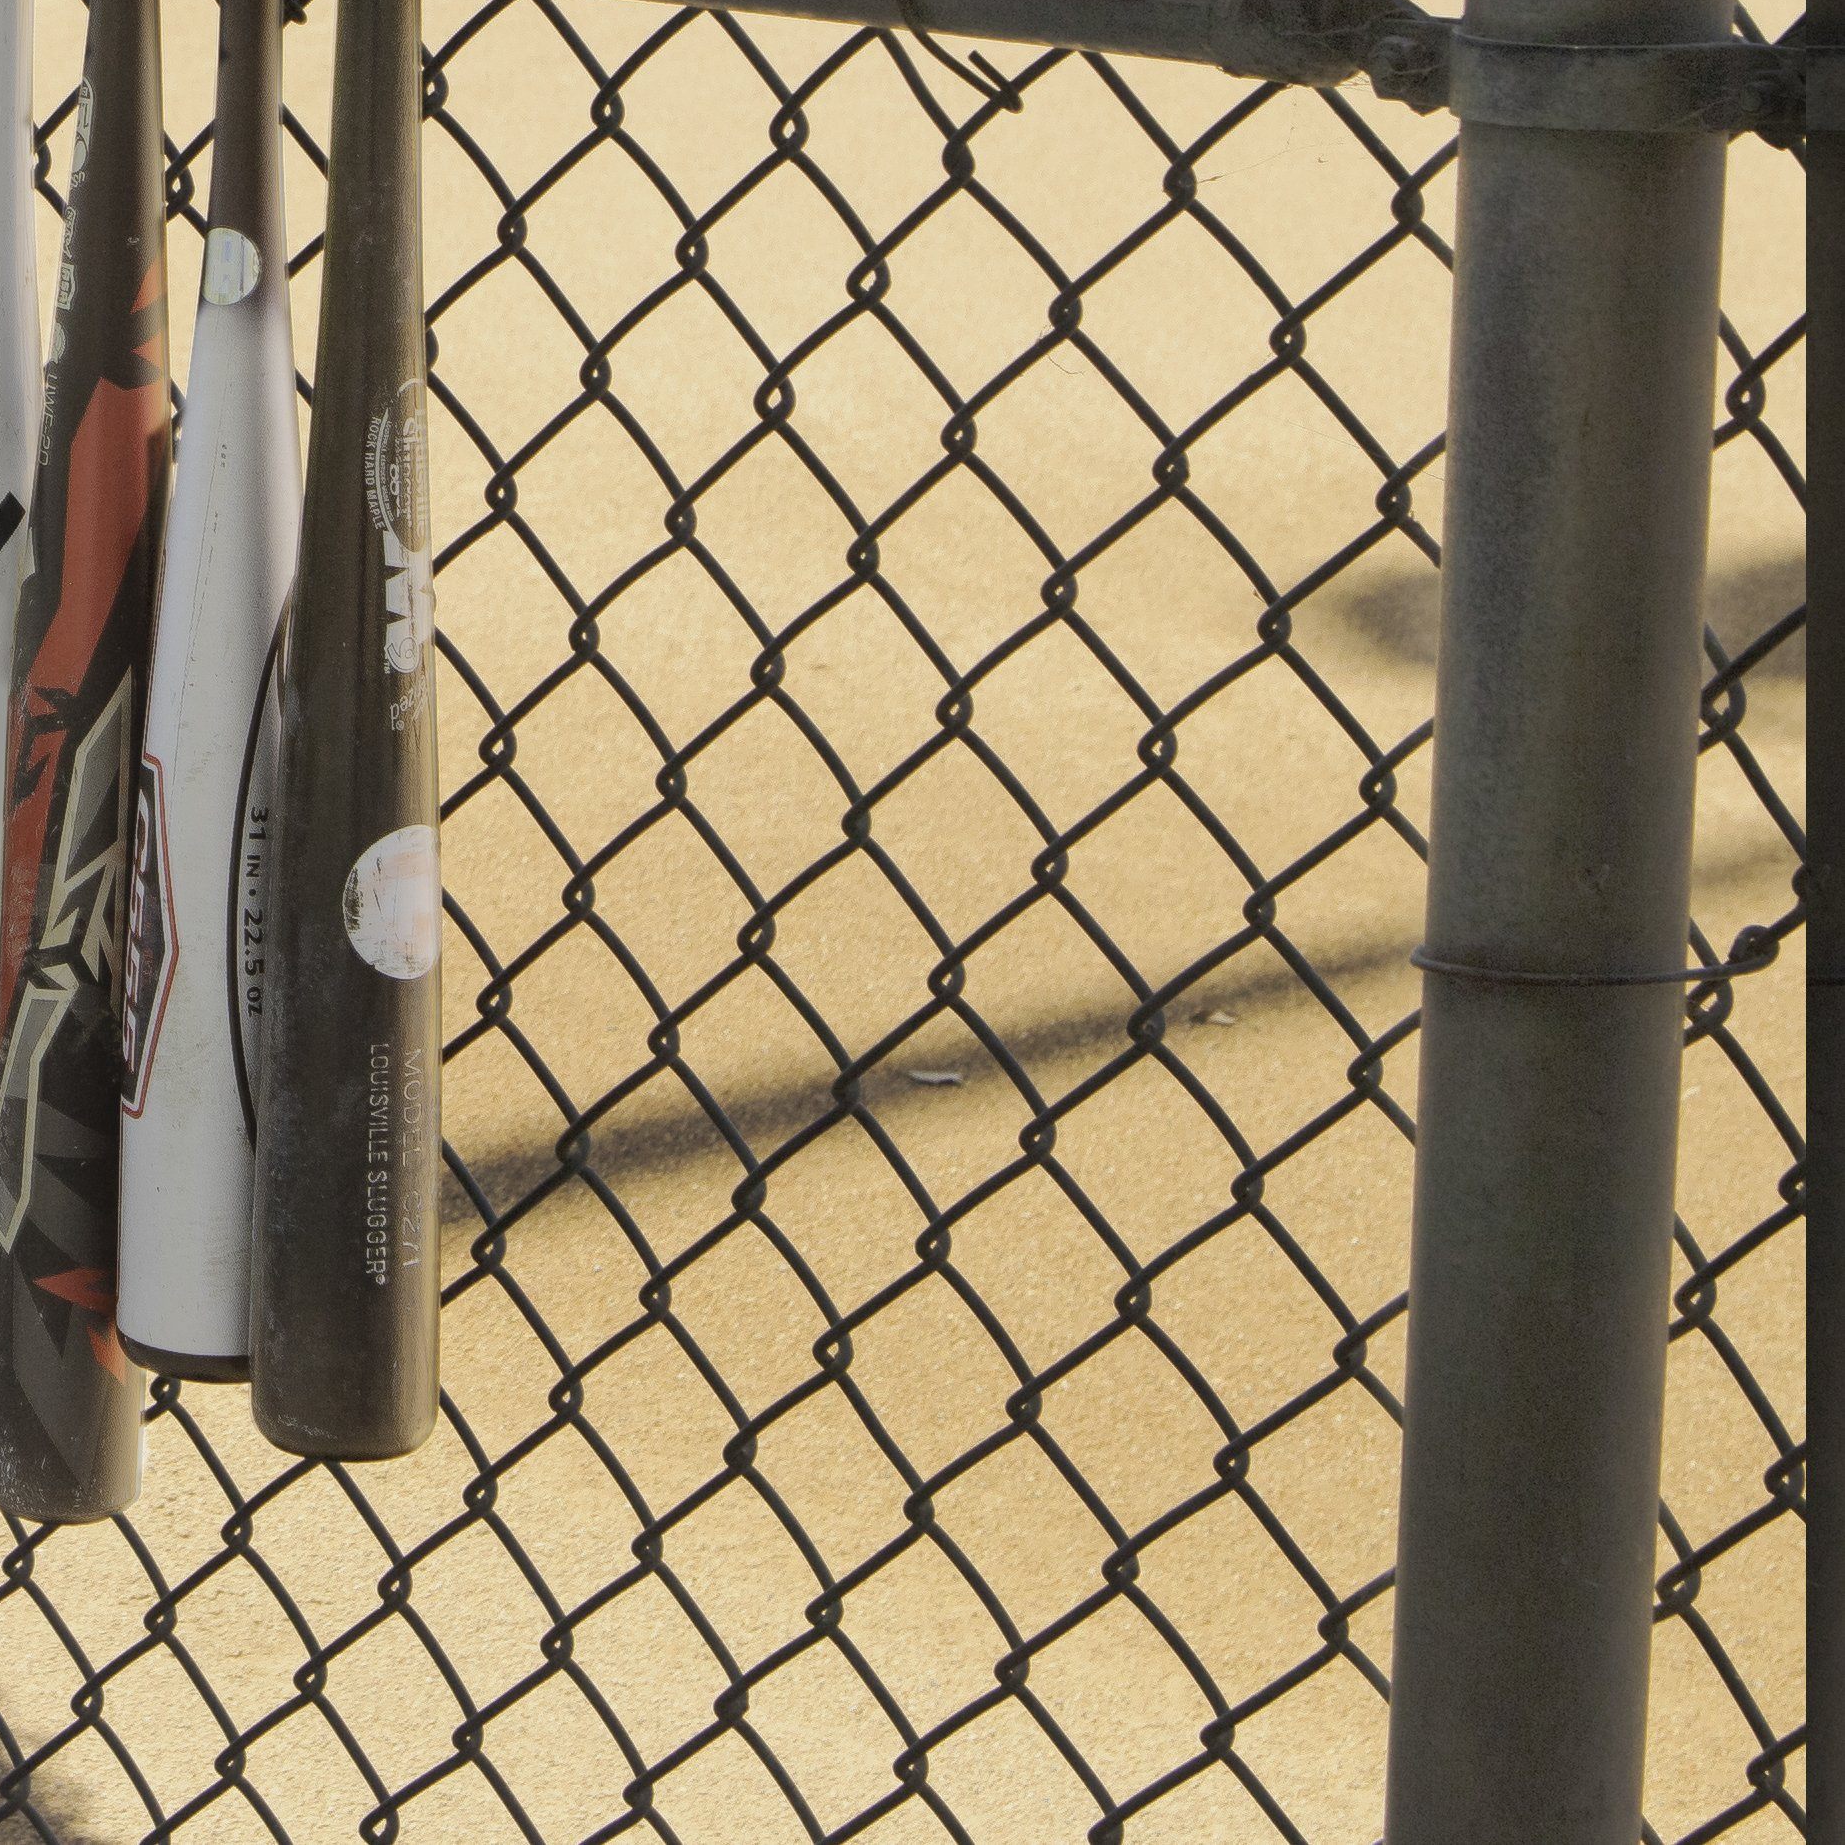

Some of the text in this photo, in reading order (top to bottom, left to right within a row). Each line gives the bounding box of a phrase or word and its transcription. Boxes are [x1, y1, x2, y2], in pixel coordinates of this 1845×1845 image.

[364, 415, 386, 531] ROCK HARD MAPLE
[245, 854, 262, 878] IN
[248, 805, 270, 841] 31
[243, 907, 266, 977] 22.5
[367, 1042, 390, 1164] LOUISVILLE
[401, 1047, 424, 1168] MODEL
